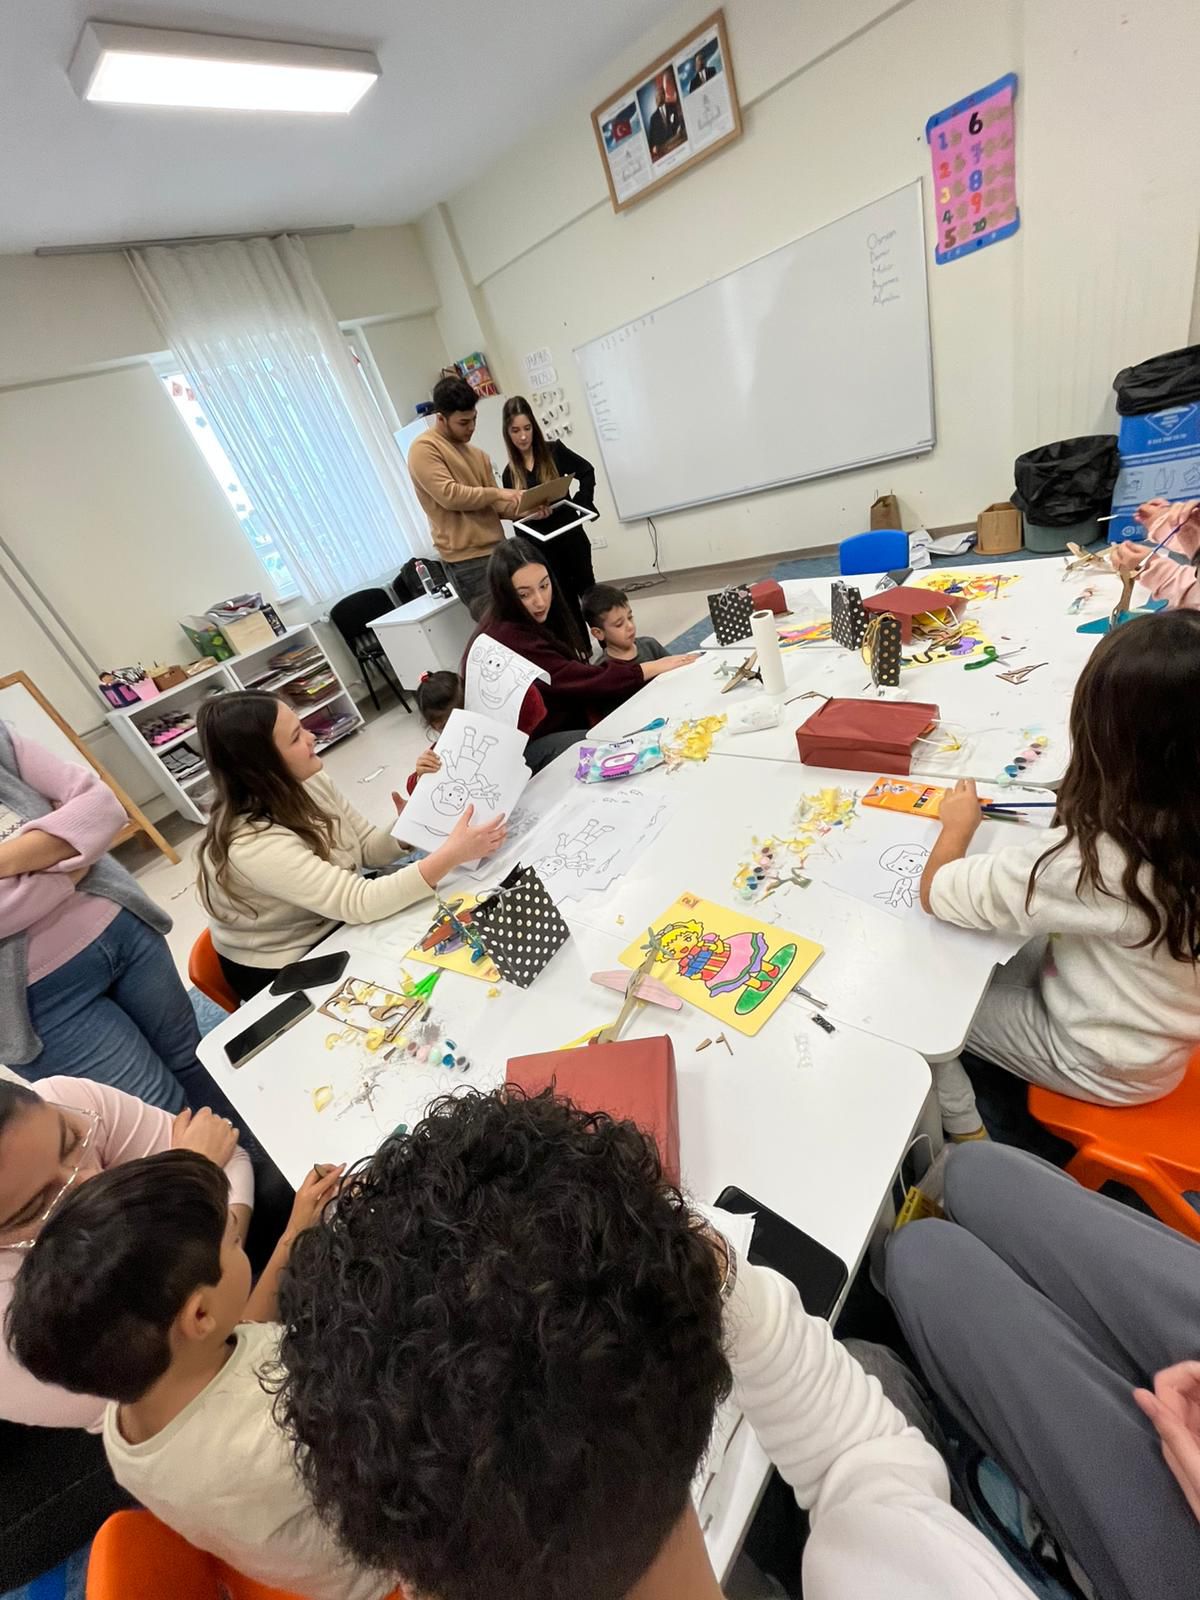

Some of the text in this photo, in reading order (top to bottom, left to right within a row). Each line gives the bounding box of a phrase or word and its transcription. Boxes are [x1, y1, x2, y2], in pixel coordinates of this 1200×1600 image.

[968, 112, 983, 135] 6
[937, 132, 948, 150] 1
[970, 141, 983, 164] 7
[939, 162, 951, 179] 2
[968, 170, 983, 192] 8
[940, 187, 951, 204] 3
[970, 192, 982, 214] 9
[942, 210, 953, 224] 4
[972, 216, 987, 234] 10
[944, 226, 957, 249] 5
